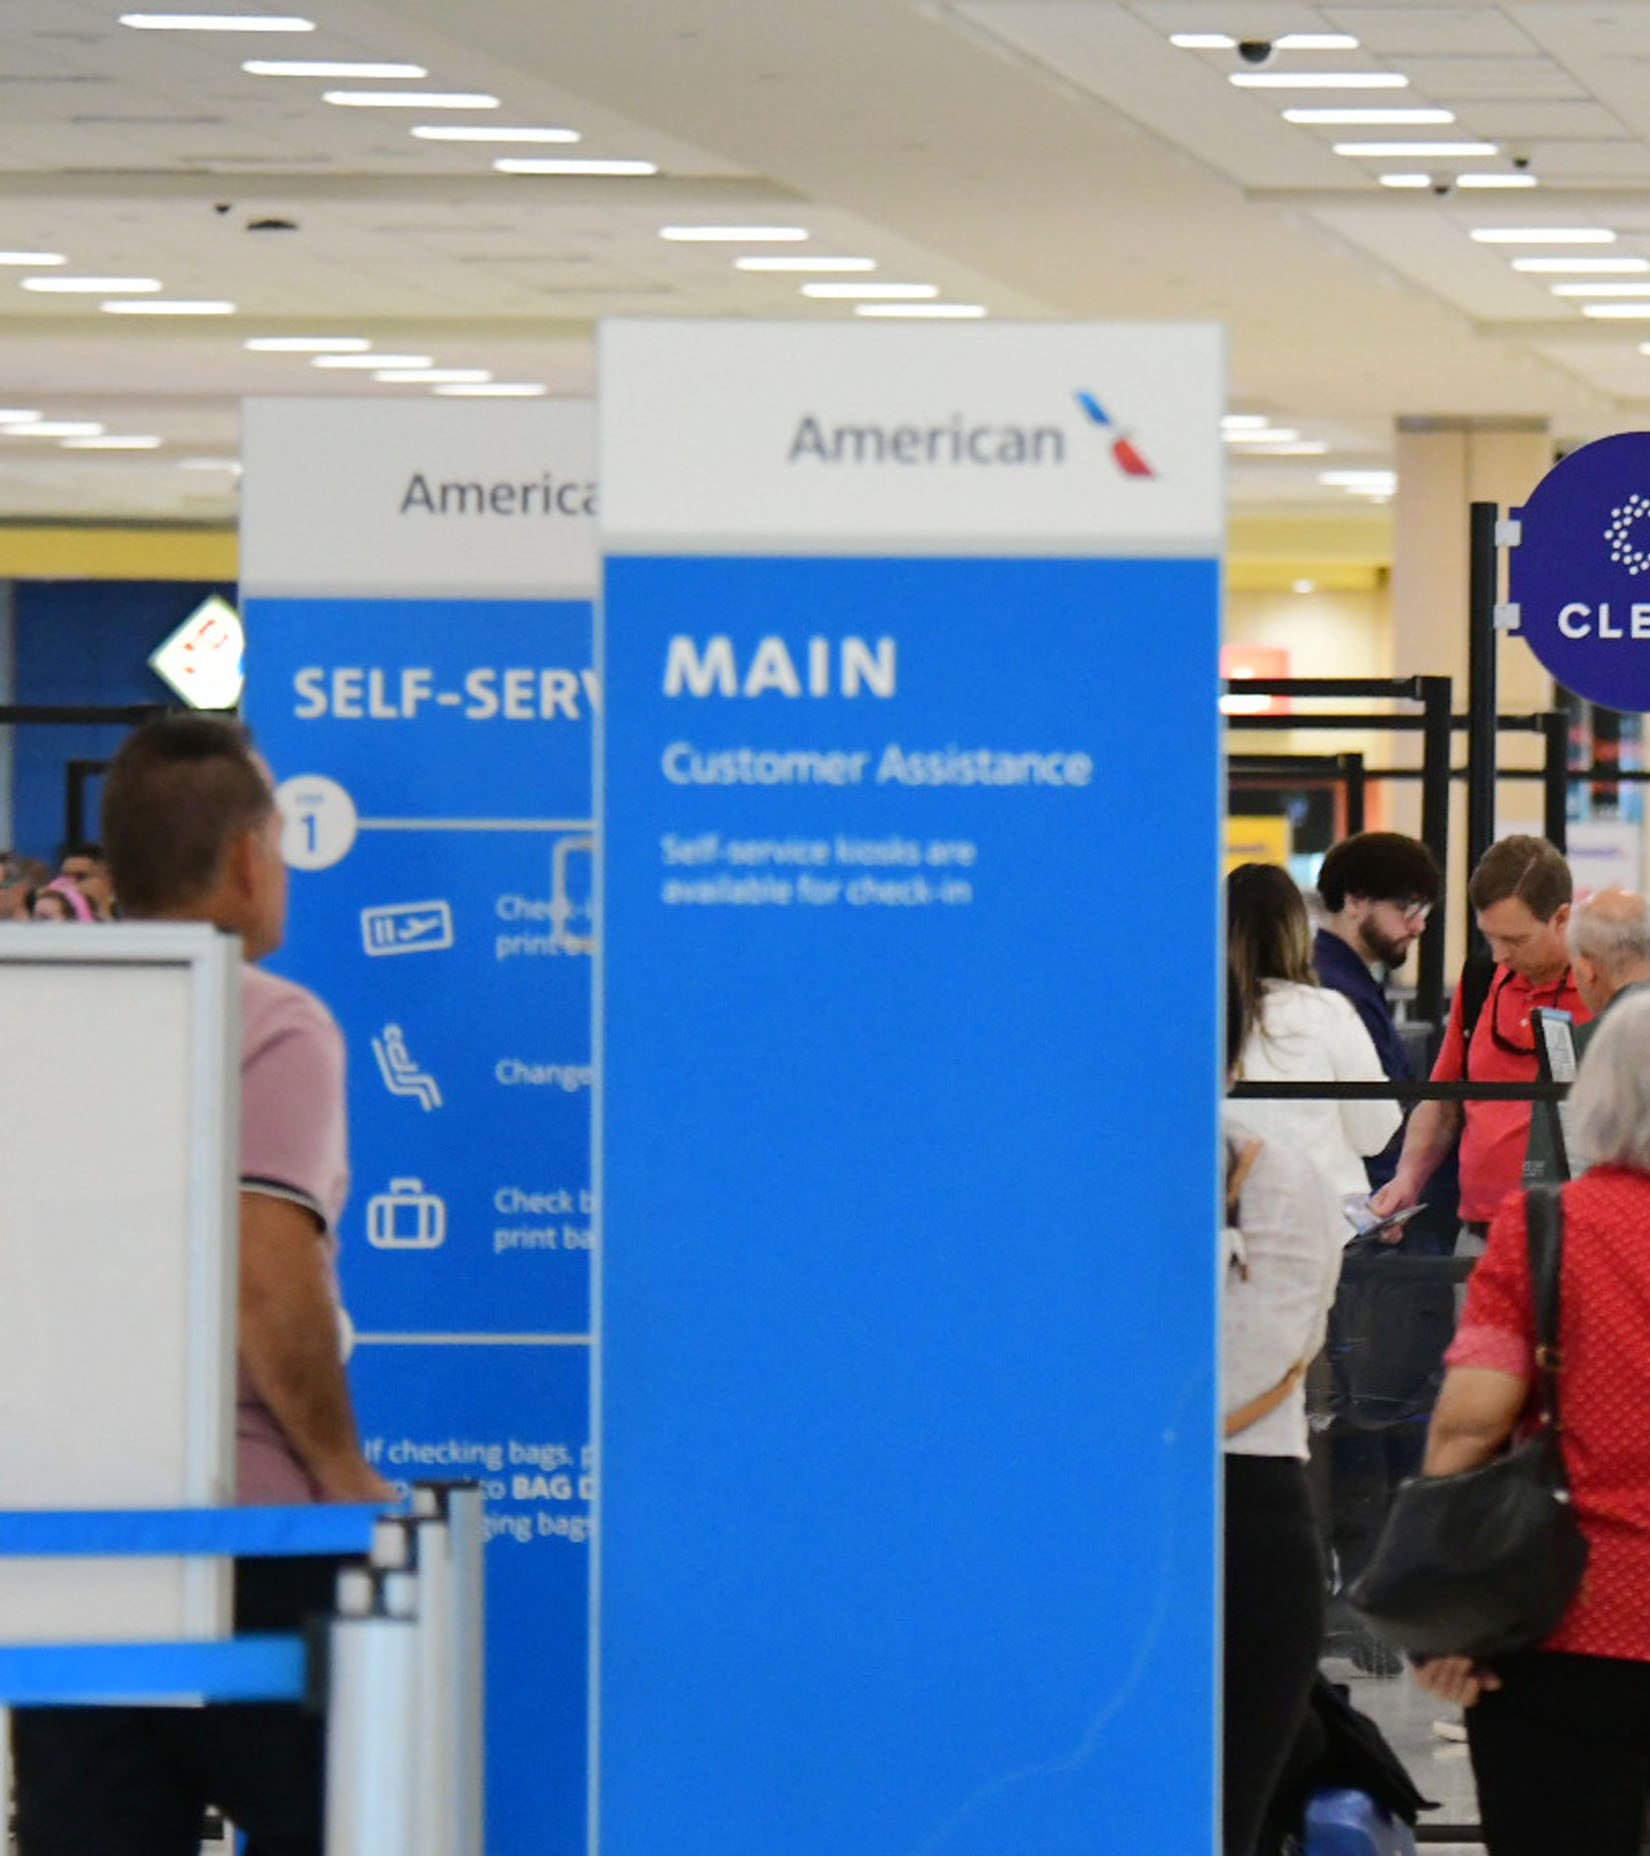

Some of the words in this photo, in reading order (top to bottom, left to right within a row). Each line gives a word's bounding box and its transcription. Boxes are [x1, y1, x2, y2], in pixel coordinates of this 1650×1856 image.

[786, 413, 1066, 464] American
[662, 634, 897, 699] MAIN
[661, 741, 870, 786] Customer
[876, 742, 1095, 787] Assistance
[302, 812, 316, 854] 1
[661, 832, 831, 867] Self-service
[834, 833, 922, 867] kiosks
[925, 839, 977, 867] are
[661, 873, 794, 905] available
[796, 873, 842, 905] for
[846, 873, 974, 905] check-in
[494, 1186, 574, 1215] Check
[494, 1224, 558, 1255] print
[387, 1439, 504, 1471] checking
[512, 1474, 573, 1501] BAG
